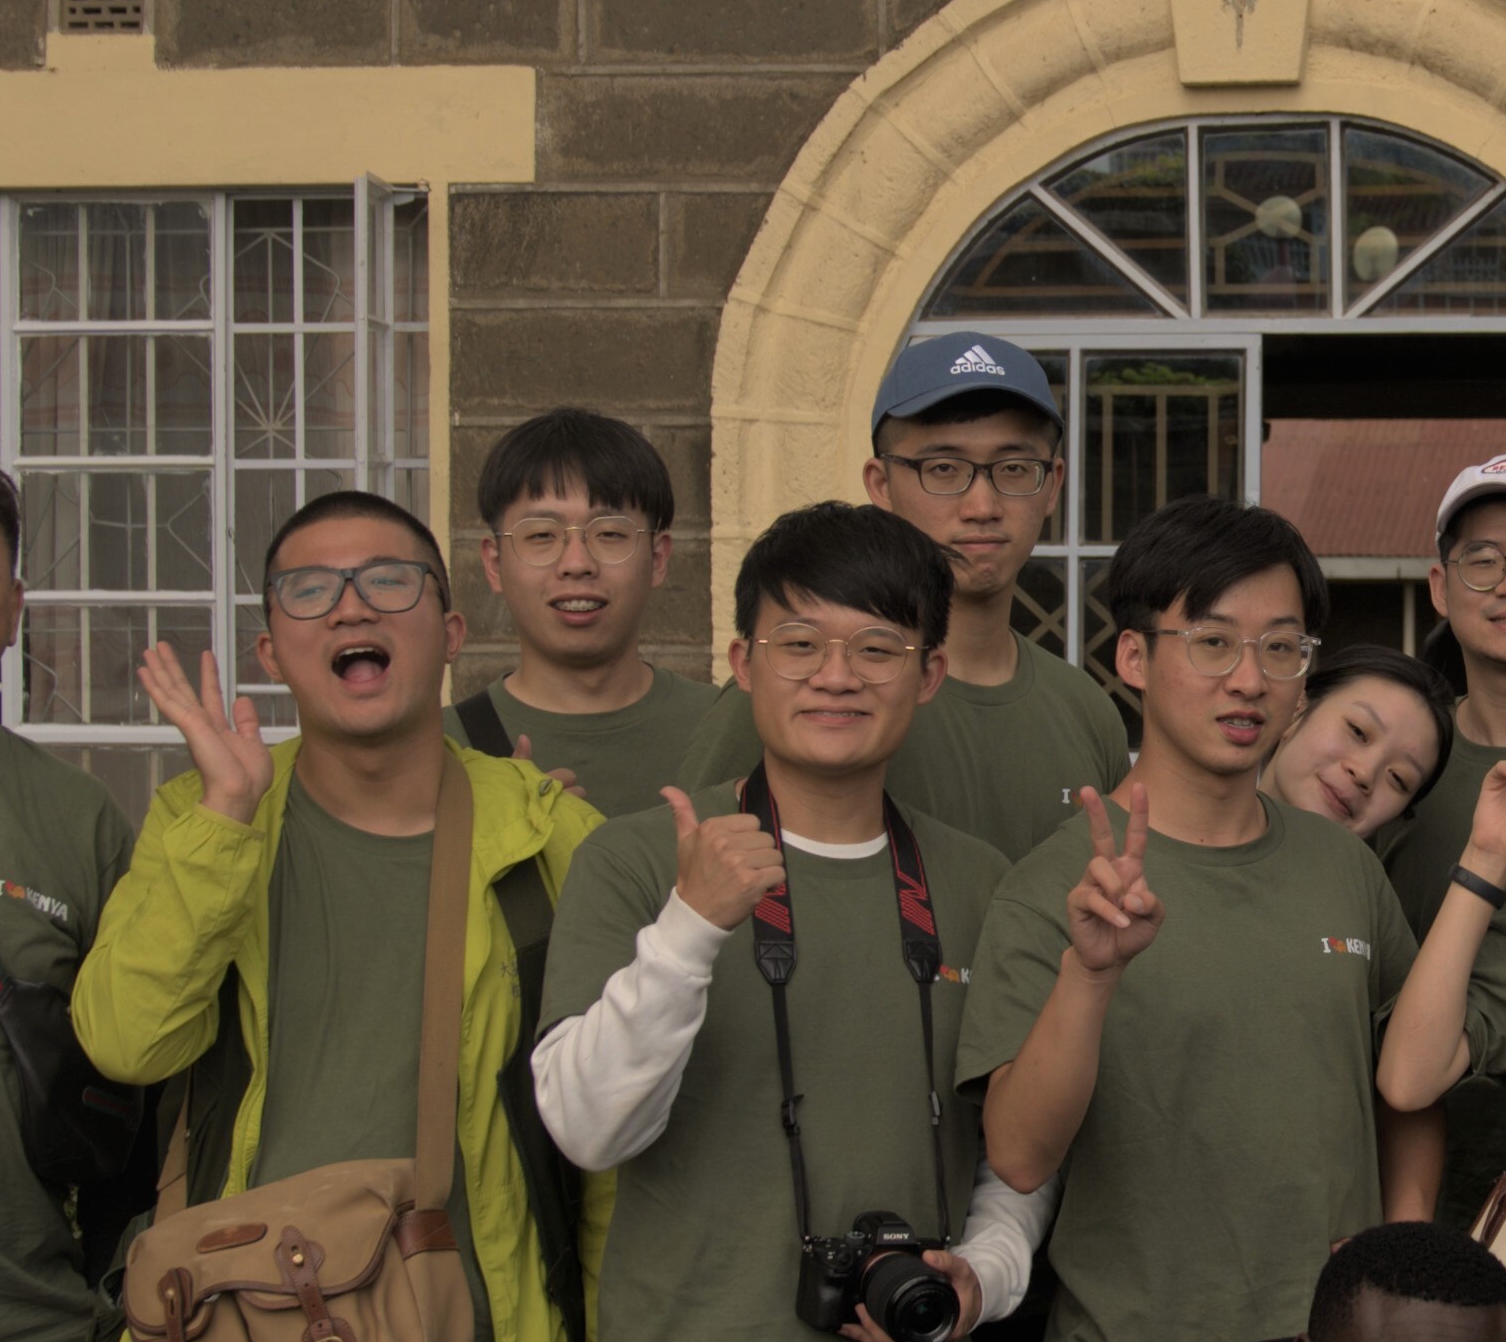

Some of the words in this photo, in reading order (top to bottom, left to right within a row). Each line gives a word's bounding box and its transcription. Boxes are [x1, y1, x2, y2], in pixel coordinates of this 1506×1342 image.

[950, 361, 1005, 376] adidas
[1061, 788, 1071, 804] I
[26, 886, 69, 922] KENYA
[1321, 937, 1332, 954] I
[883, 1232, 910, 1240] SONY
